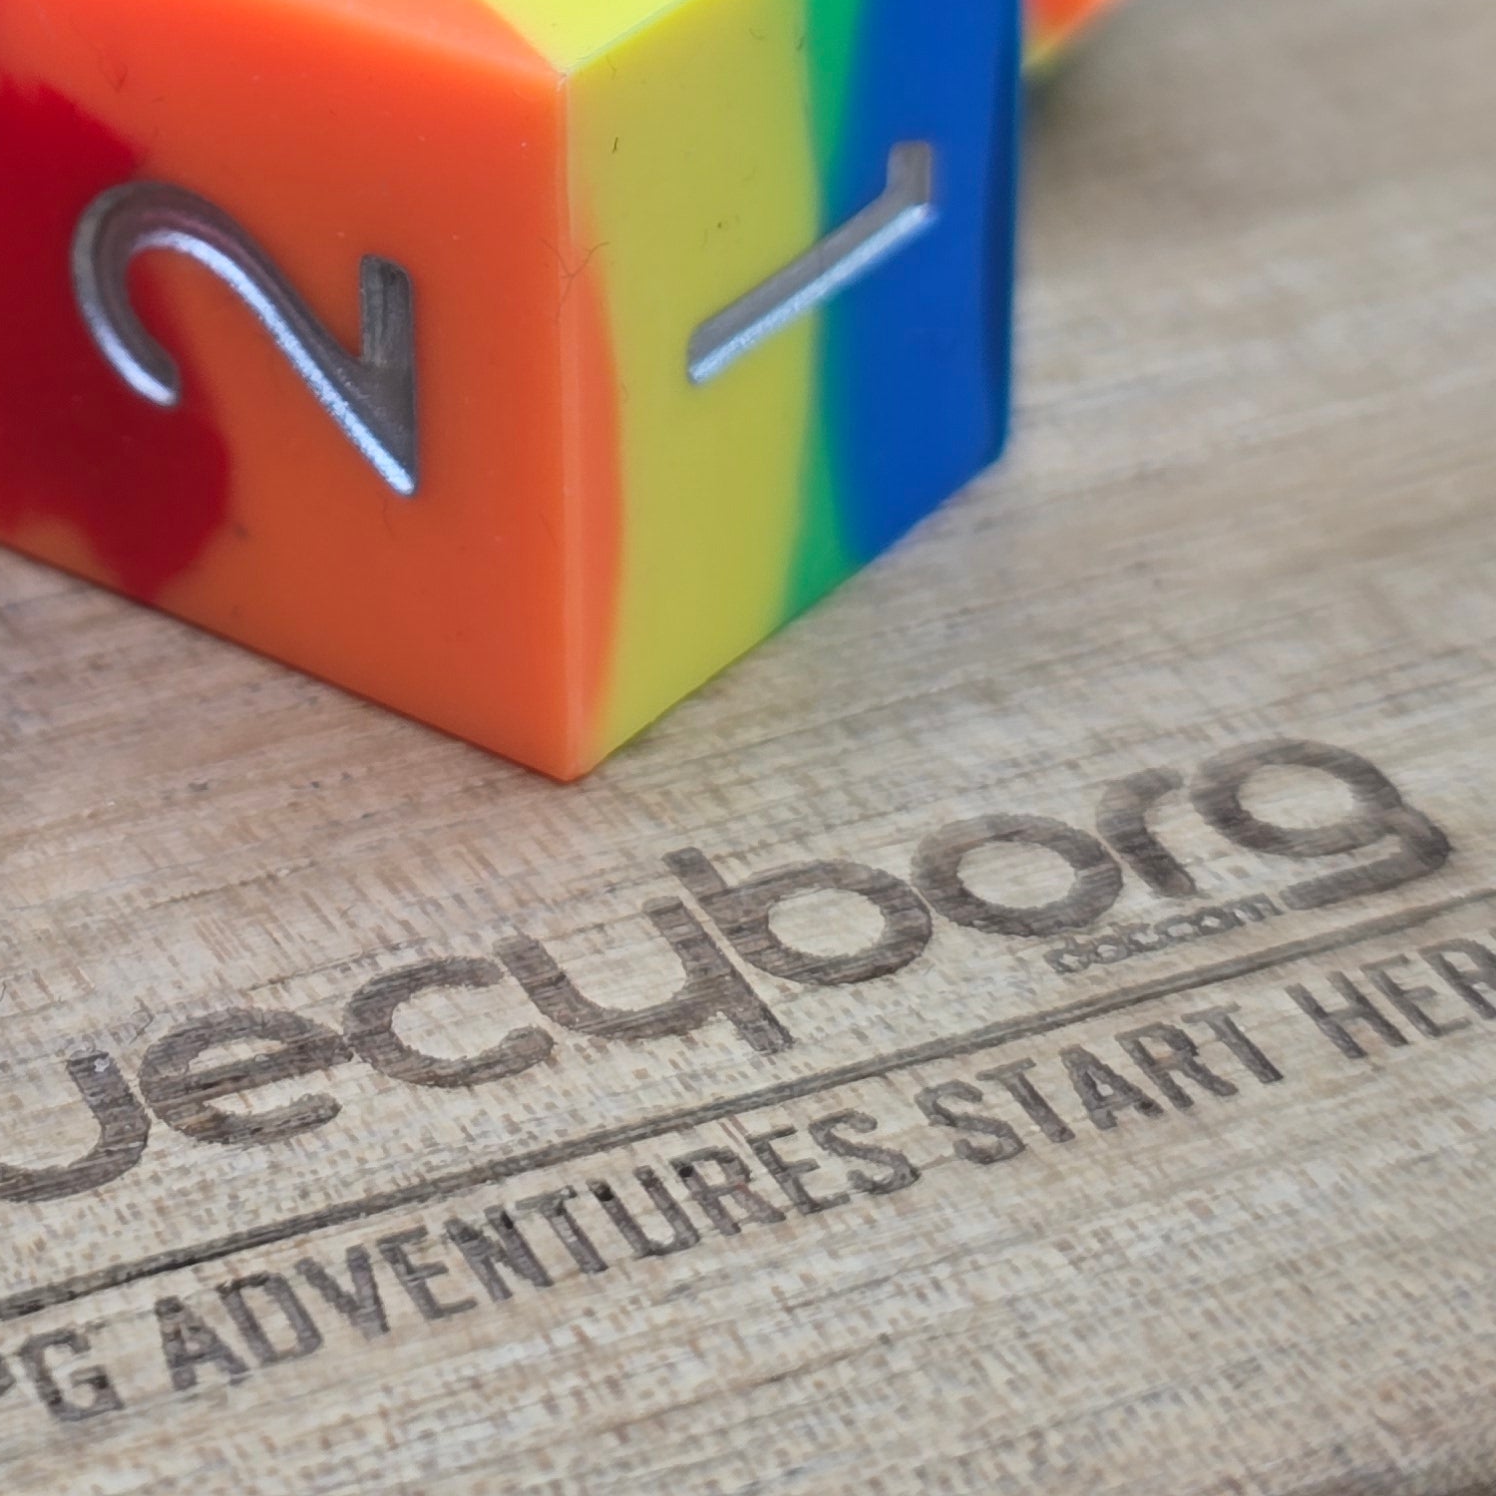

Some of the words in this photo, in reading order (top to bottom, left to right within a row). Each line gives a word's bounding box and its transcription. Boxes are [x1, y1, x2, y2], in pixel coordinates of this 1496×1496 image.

[71, 180, 419, 497] 2
[686, 140, 936, 384] 1
[154, 1108, 922, 1391] ADVENTURES
[913, 1001, 1285, 1166] START
[1284, 926, 1496, 1060] HER
